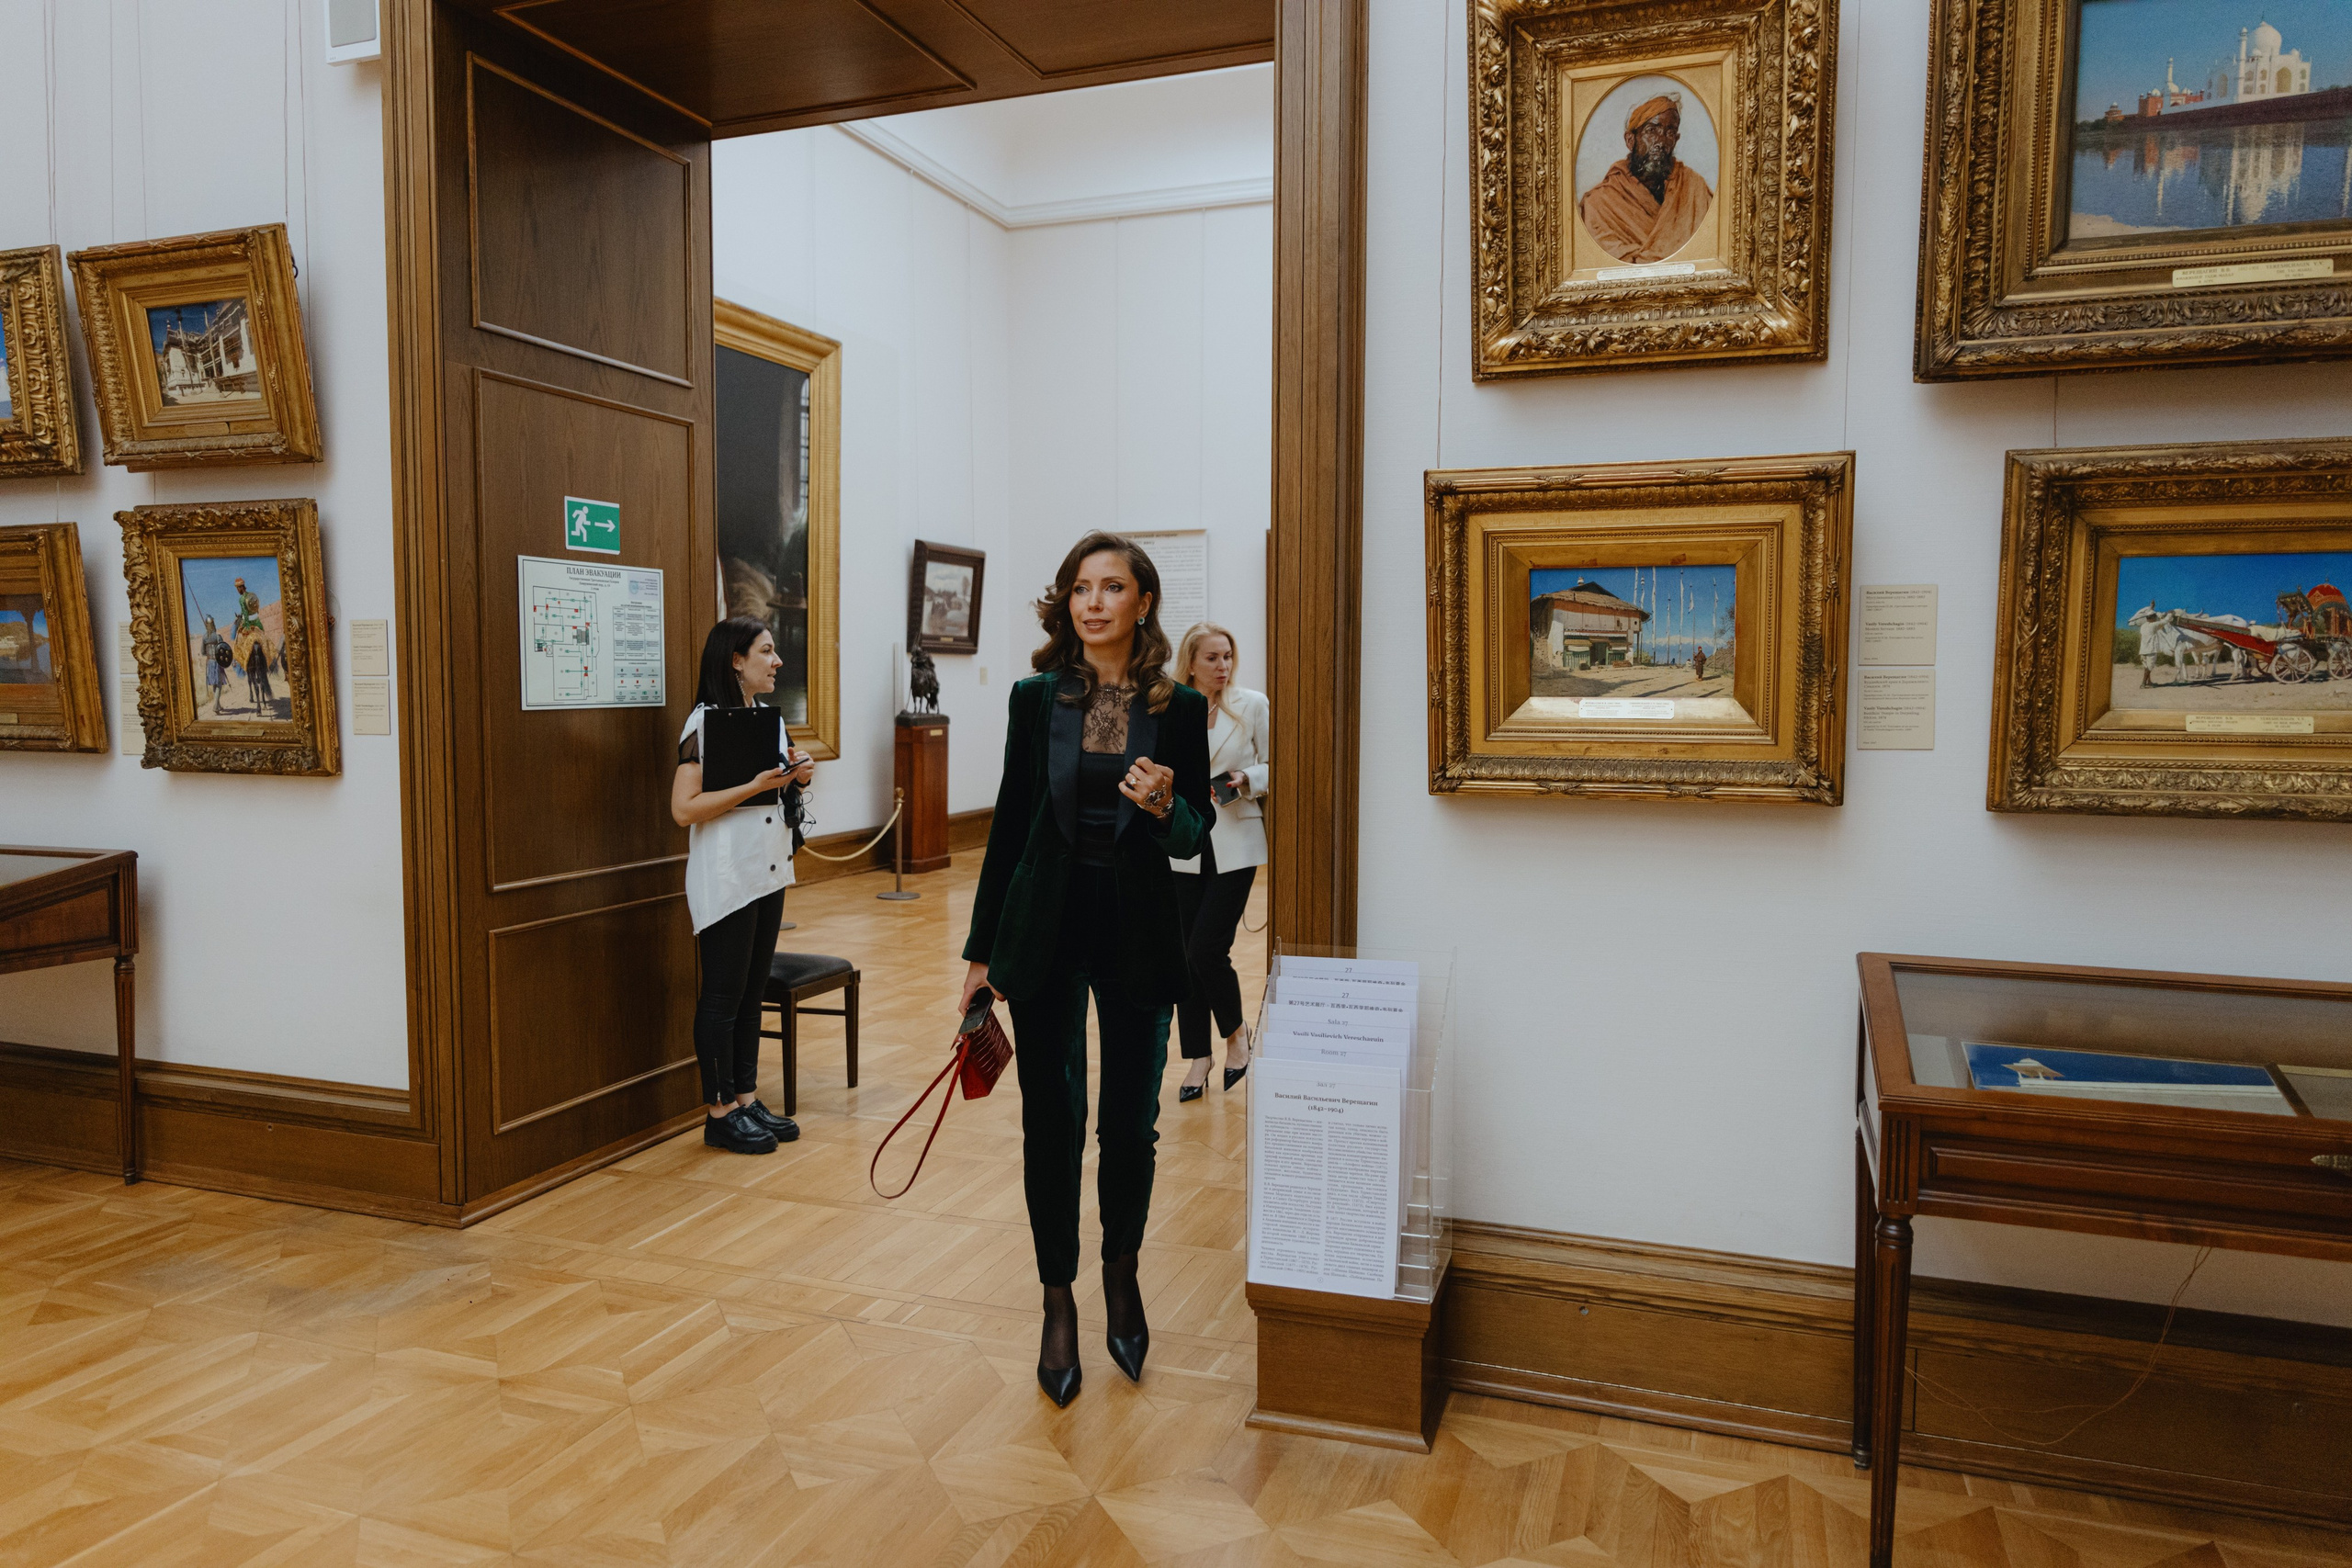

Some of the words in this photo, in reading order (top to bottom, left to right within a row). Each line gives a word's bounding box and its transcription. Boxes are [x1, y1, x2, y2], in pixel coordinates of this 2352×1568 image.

[566, 567, 584, 575] ПЛАН
[585, 569, 621, 580] ЭВАКУАЦИИ
[1310, 1032, 1342, 1040] Vasilievich
[1274, 1092, 1302, 1100] Василий
[1303, 1094, 1340, 1102] Васильевич
[1341, 1098, 1378, 1106] Верещагин
